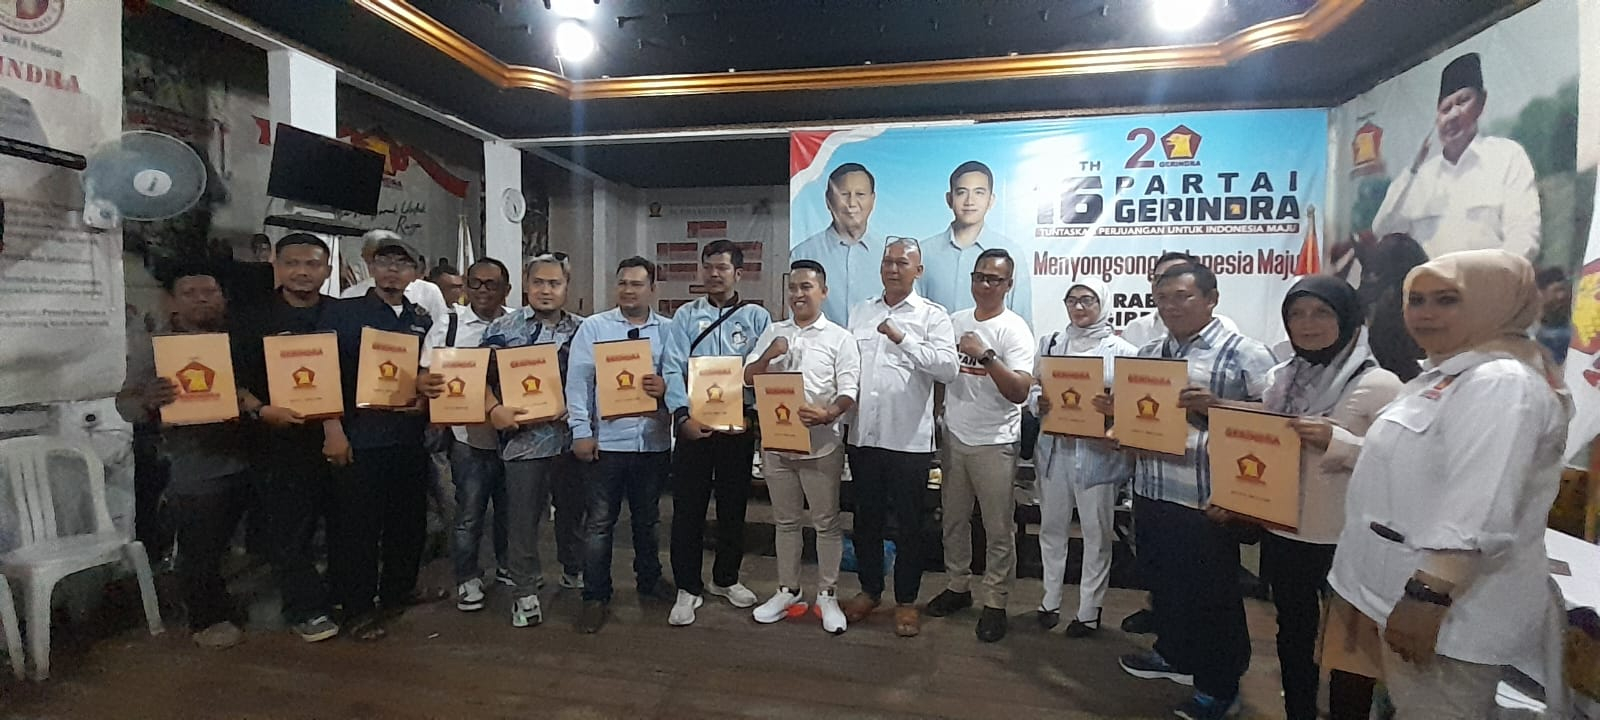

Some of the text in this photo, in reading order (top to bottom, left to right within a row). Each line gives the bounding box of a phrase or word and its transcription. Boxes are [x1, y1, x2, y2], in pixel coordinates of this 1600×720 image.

[1079, 160, 1101, 171] TH
[1159, 160, 1201, 168] GERINDRA
[1115, 171, 1298, 196] PARTAI
[1114, 195, 1300, 223] GERINDRA
[1040, 223, 1297, 236] TUNTASKA PERJUANGAN UNTUK INDONESIA MAJU
[1033, 250, 1158, 283] Menyongsong
